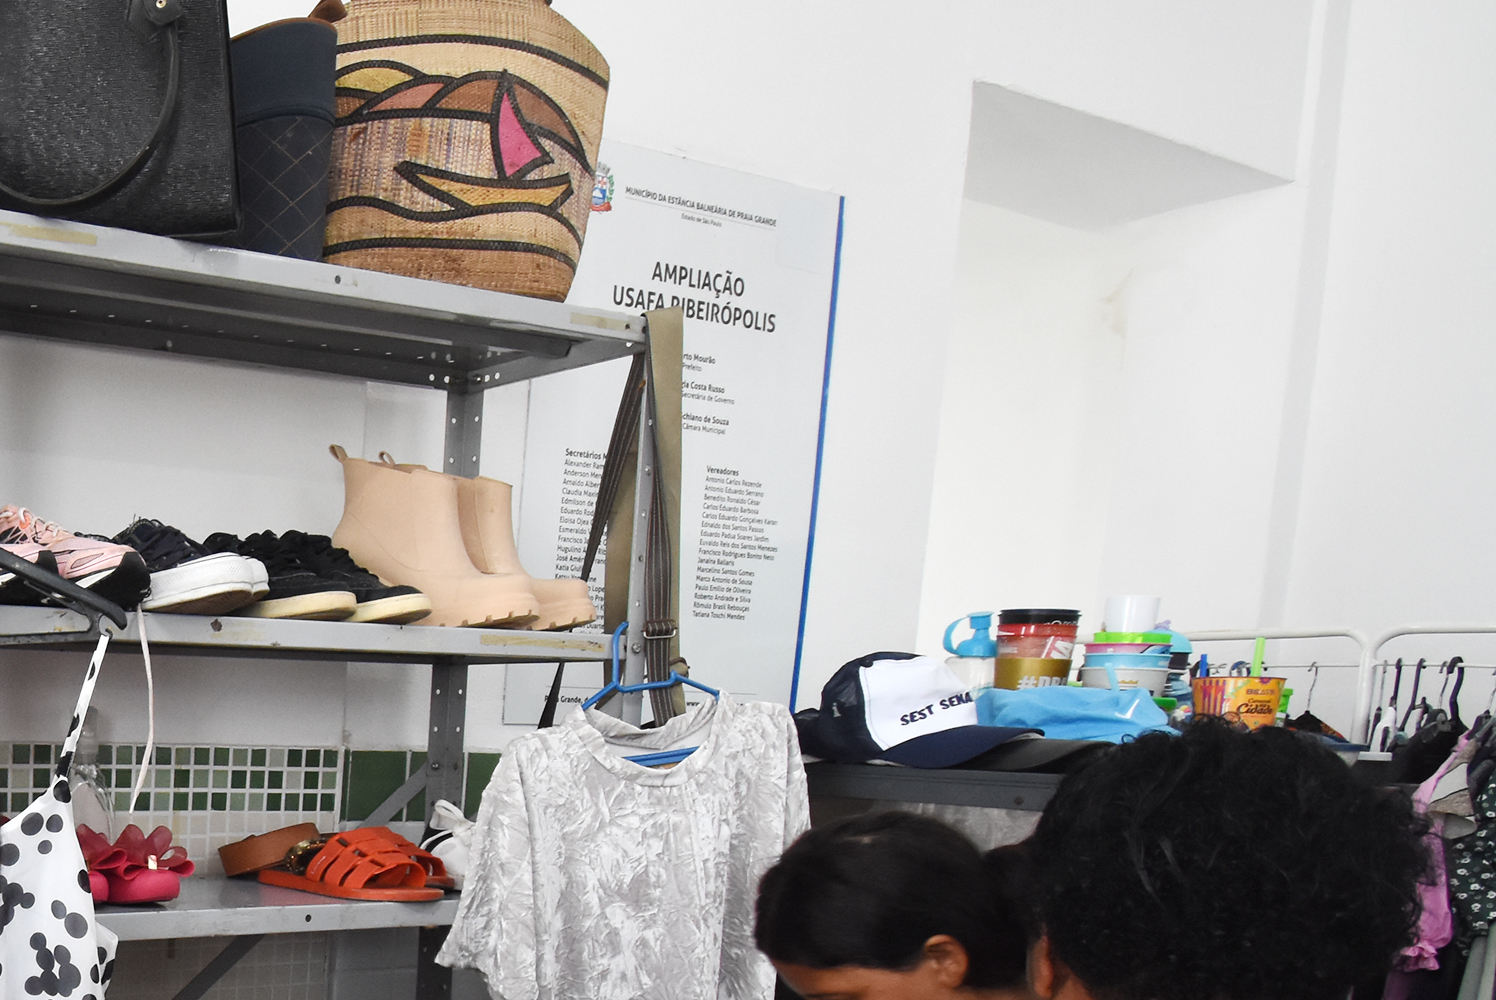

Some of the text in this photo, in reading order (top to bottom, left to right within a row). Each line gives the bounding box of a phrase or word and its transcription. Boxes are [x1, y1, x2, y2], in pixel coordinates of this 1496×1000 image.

[625, 186, 777, 227] MUNICÍPIO DA ESTÂNCIA BALNEÁRIA DE PRAIA GRANDE
[681, 213, 695, 222] Estado
[711, 219, 722, 227] Paulo
[652, 261, 745, 298] AMPLIAÇÃO
[613, 285, 665, 310] USAFA
[694, 354, 716, 364] Mourão
[690, 381, 707, 391] Costa
[708, 384, 725, 394] Russo
[714, 395, 735, 405] Governo
[712, 416, 729, 426] Souza
[702, 425, 726, 435] Municipal
[565, 448, 601, 460] Secretários
[564, 459, 592, 468] Alexander
[564, 469, 589, 477] Anderson
[707, 465, 739, 476] Vereadores
[563, 478, 584, 487] Arnaldo
[706, 476, 725, 484] Antonio
[726, 478, 741, 486] Carlos
[705, 485, 764, 497] Antonio Eduardo Serrano
[562, 497, 585, 506] Edmilson
[727, 496, 746, 504] Ronaldo
[561, 507, 594, 516] Eduardo Rod
[703, 503, 759, 515] Carlos Eduardo Barbosa
[702, 512, 717, 520] Carlos
[718, 513, 738, 522] Eduardo
[739, 515, 763, 525] Gonçalves
[559, 525, 587, 535] Esmeraldo
[701, 521, 721, 529] Ednaldo
[731, 524, 747, 532] Santos
[558, 535, 582, 544] Francisco
[700, 530, 720, 538] Eduardo
[737, 533, 753, 541] Soares
[741, 542, 756, 551] Santos
[758, 545, 778, 553] Menezes
[699, 547, 721, 556] Francisco
[722, 550, 745, 559] Rodrigues
[570, 555, 584, 563] Amér
[697, 566, 755, 577] Marcelino Santos Gomes
[712, 576, 730, 584] Antonio
[592, 585, 605, 594] Lope
[733, 586, 752, 595] Oliveira
[694, 592, 713, 601] Roberto
[715, 594, 734, 602] Andrade
[727, 604, 750, 613] Rebouças
[693, 610, 710, 618] Tatiana
[726, 613, 745, 621] Mendes
[561, 695, 583, 704] Grande,
[900, 691, 974, 726] SEST SENA
[1236, 703, 1273, 714] Cidade
